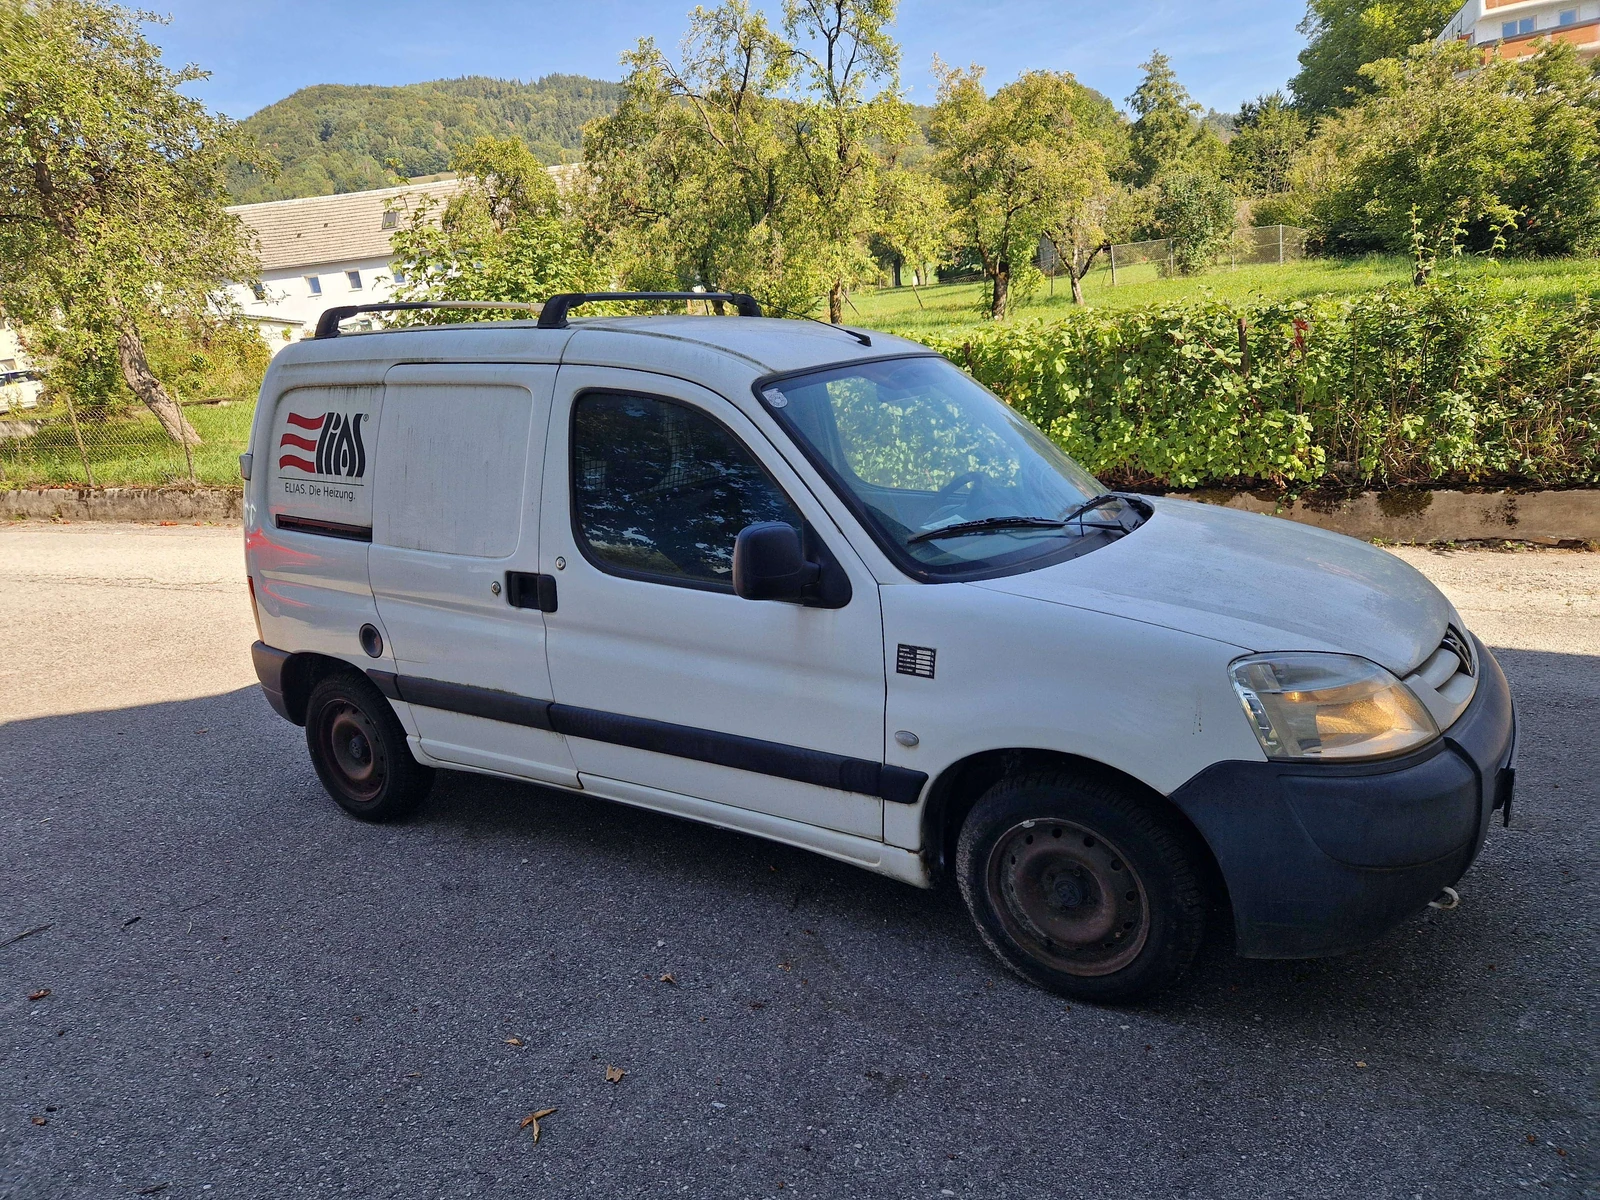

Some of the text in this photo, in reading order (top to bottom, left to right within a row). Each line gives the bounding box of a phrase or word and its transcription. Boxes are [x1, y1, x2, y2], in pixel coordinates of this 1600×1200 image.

[284, 482, 355, 502] ELIAS. Die Heizung.
